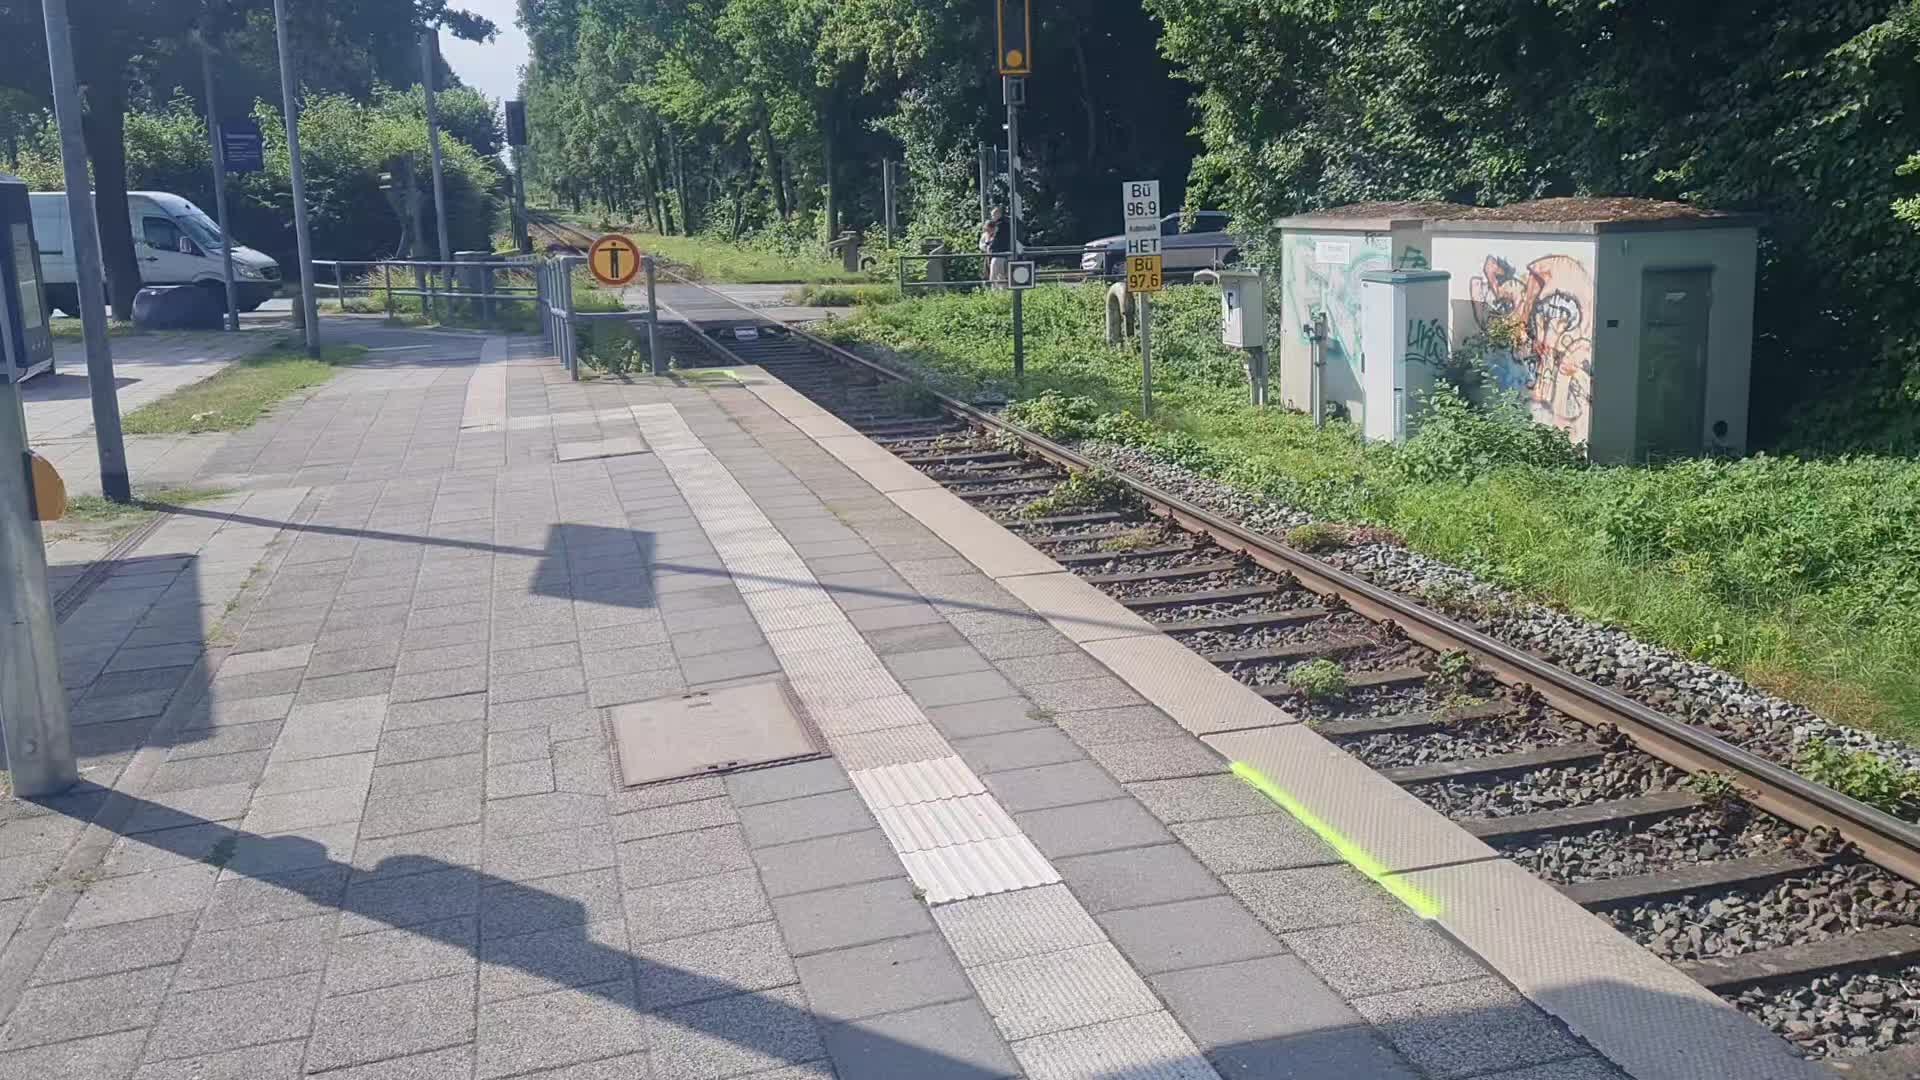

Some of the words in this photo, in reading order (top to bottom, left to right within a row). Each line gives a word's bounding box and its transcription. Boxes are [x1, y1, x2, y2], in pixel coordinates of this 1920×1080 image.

[1132, 184, 1151, 198] Bü
[1127, 201, 1157, 216] 96.9
[1128, 239, 1159, 253] HET
[1135, 258, 1153, 272] Bü
[1130, 274, 1158, 288] 97.6
